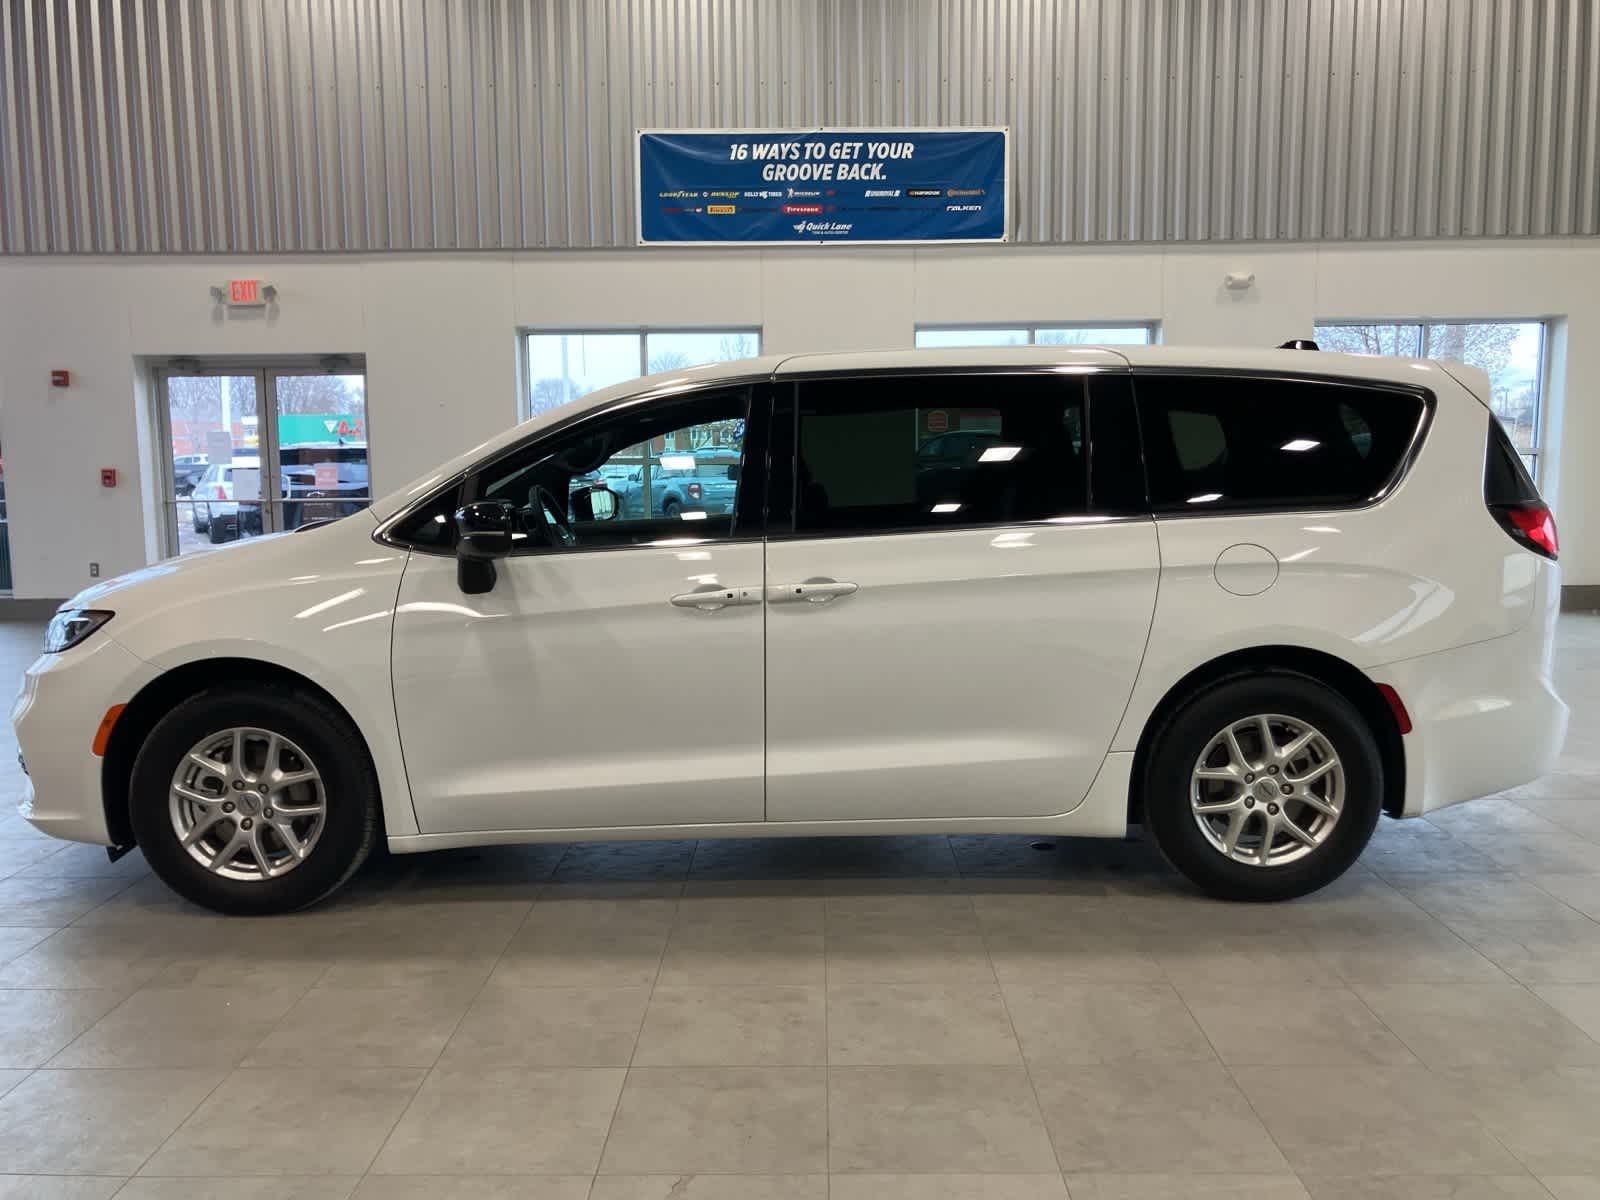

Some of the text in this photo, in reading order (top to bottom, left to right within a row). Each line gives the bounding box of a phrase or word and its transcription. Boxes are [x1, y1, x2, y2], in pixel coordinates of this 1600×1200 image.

[730, 142, 914, 161] 16 WAYS TO GET YOUR
[762, 163, 887, 181] GROOVE BACK.
[806, 222, 853, 231] Quick Lane
[231, 279, 257, 301] EXIT
